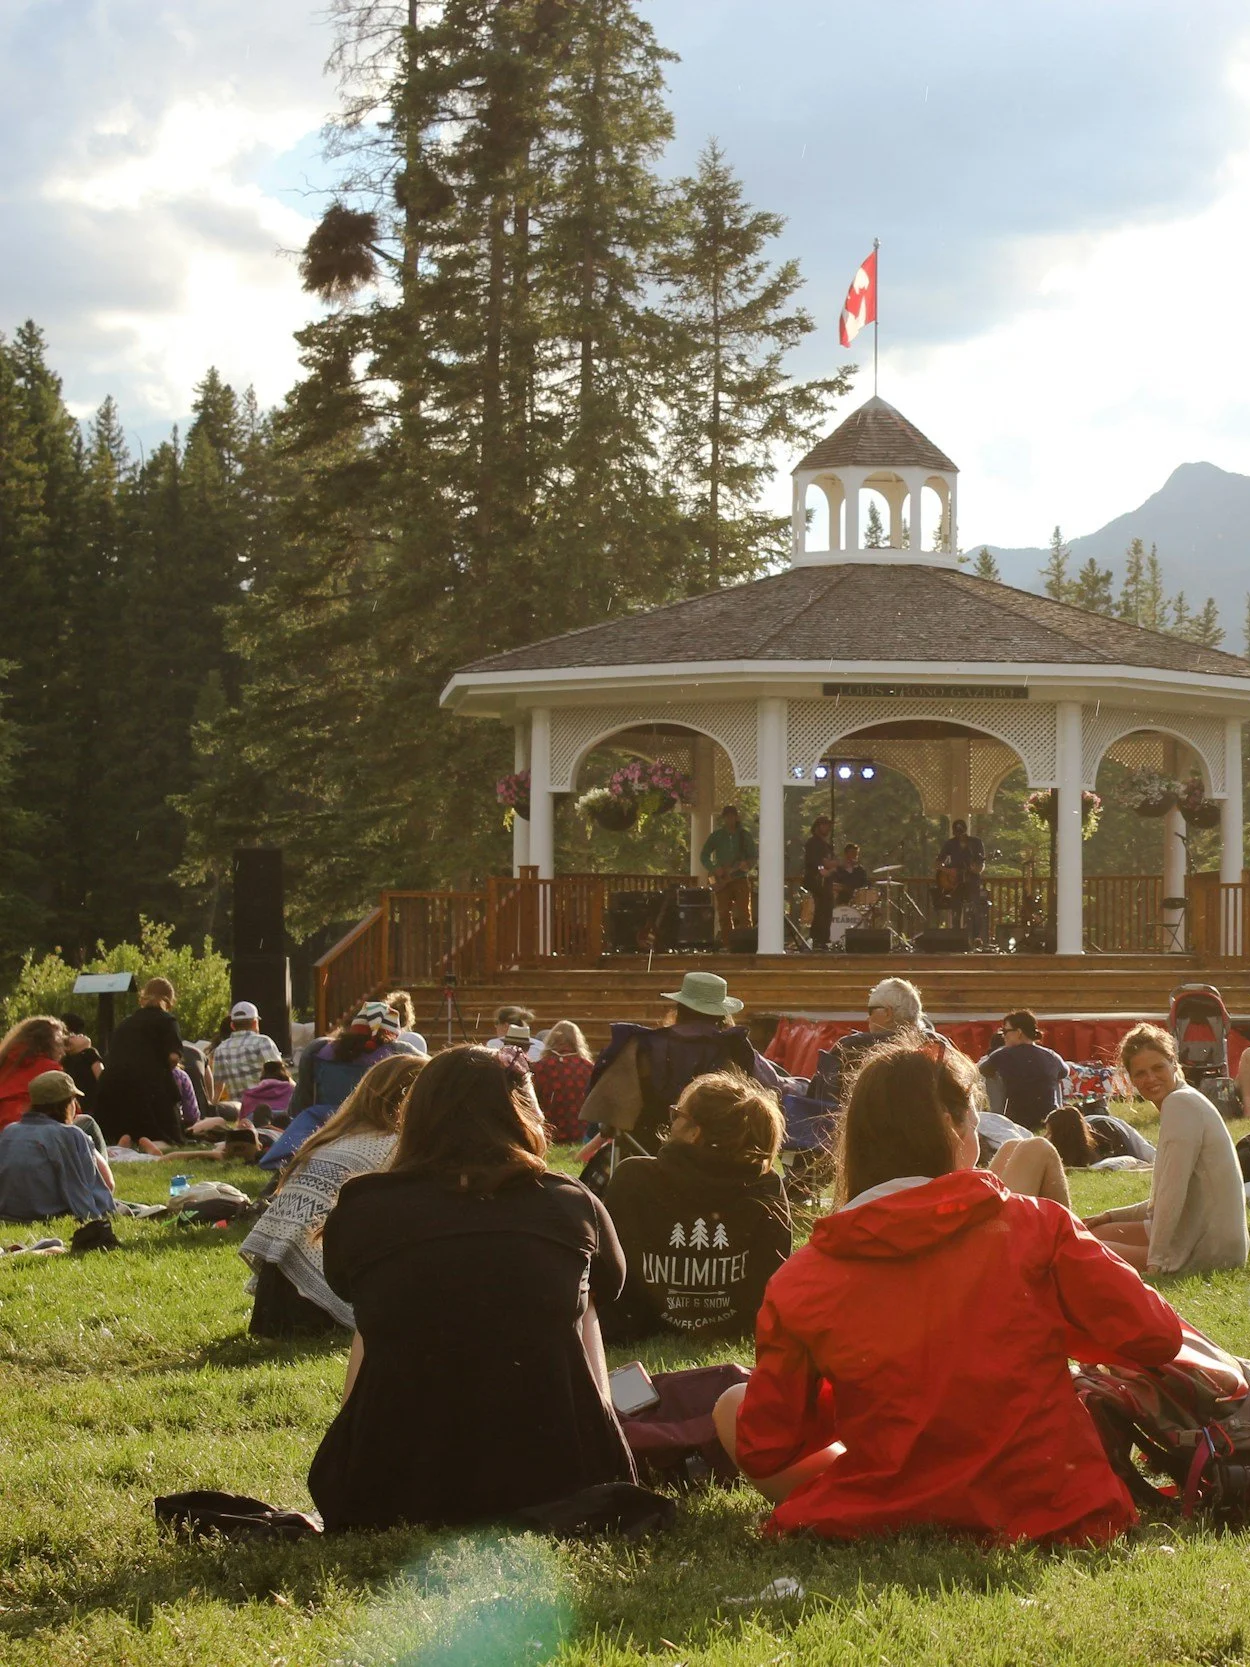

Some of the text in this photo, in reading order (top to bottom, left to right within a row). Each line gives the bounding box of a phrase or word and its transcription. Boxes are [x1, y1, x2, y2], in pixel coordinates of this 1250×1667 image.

[950, 686, 1015, 699] GAZEBO
[666, 1296, 691, 1310] SKATE
[703, 1296, 731, 1309] SNOW
